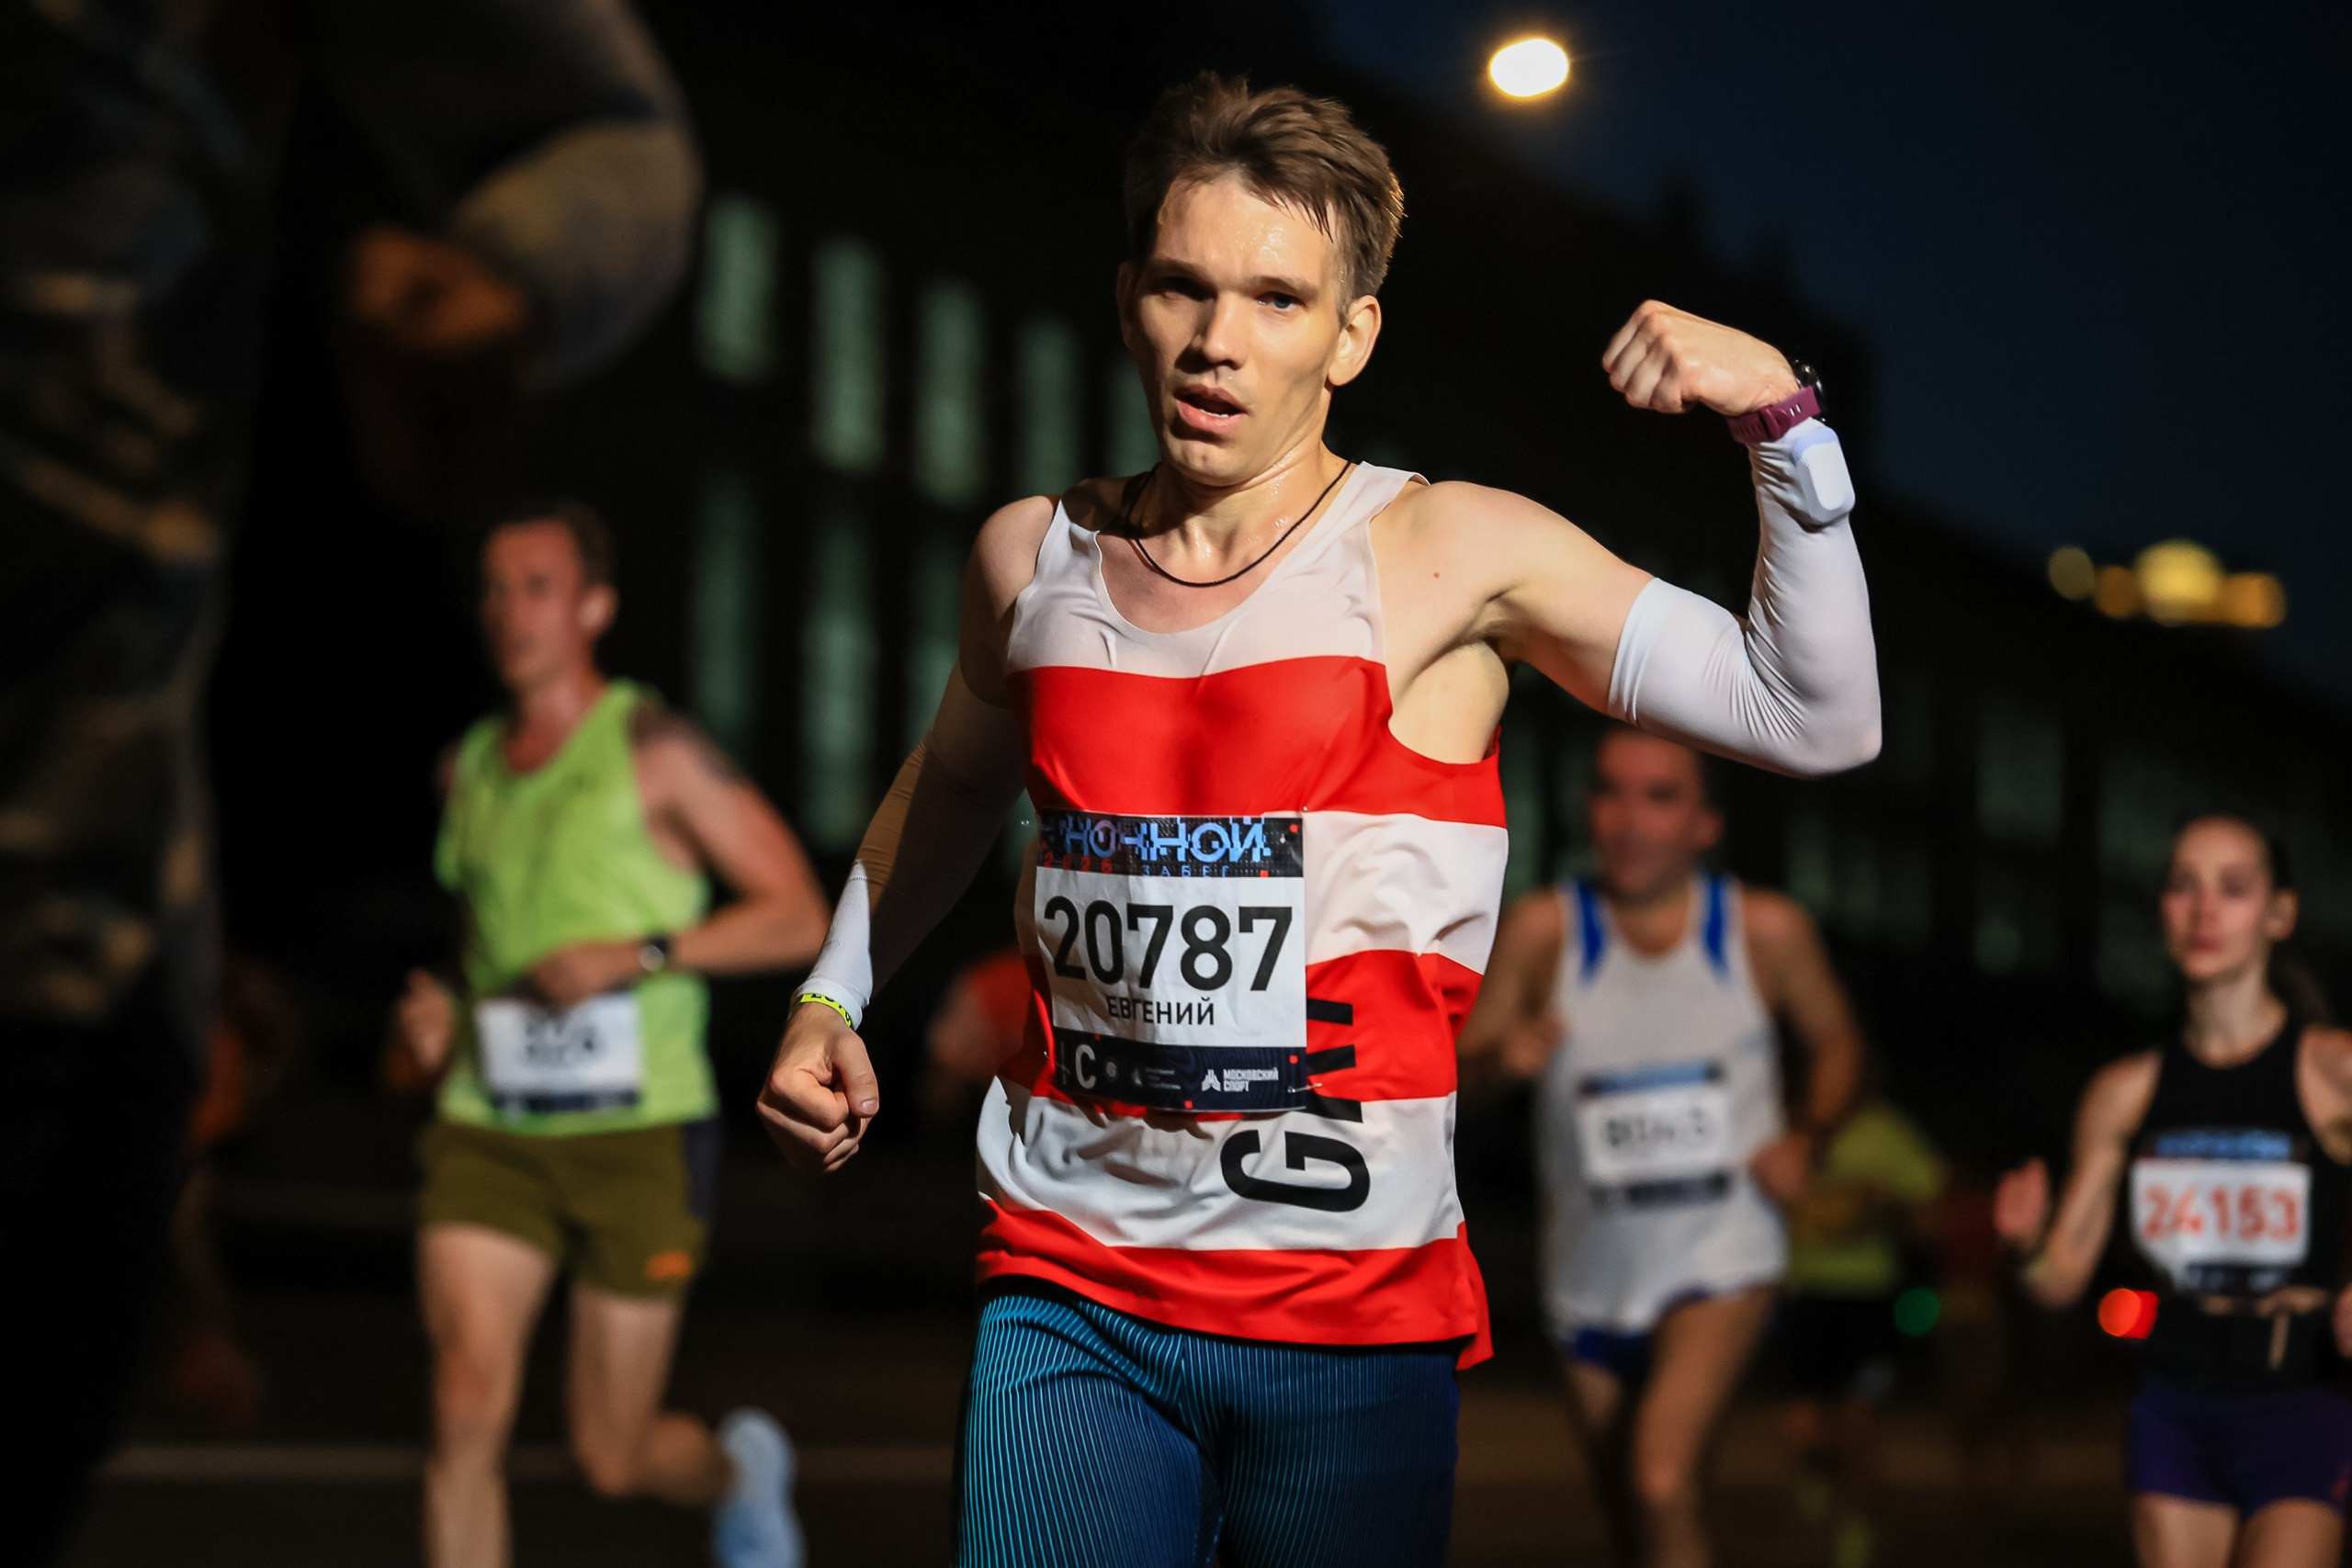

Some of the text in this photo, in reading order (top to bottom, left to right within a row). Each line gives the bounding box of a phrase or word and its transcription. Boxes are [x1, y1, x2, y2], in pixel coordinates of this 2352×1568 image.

[1142, 865, 1229, 877] ЗАБЕГ
[1044, 895, 1293, 991] 20787
[1108, 996, 1215, 1026] ЕВГЕНИЙ
